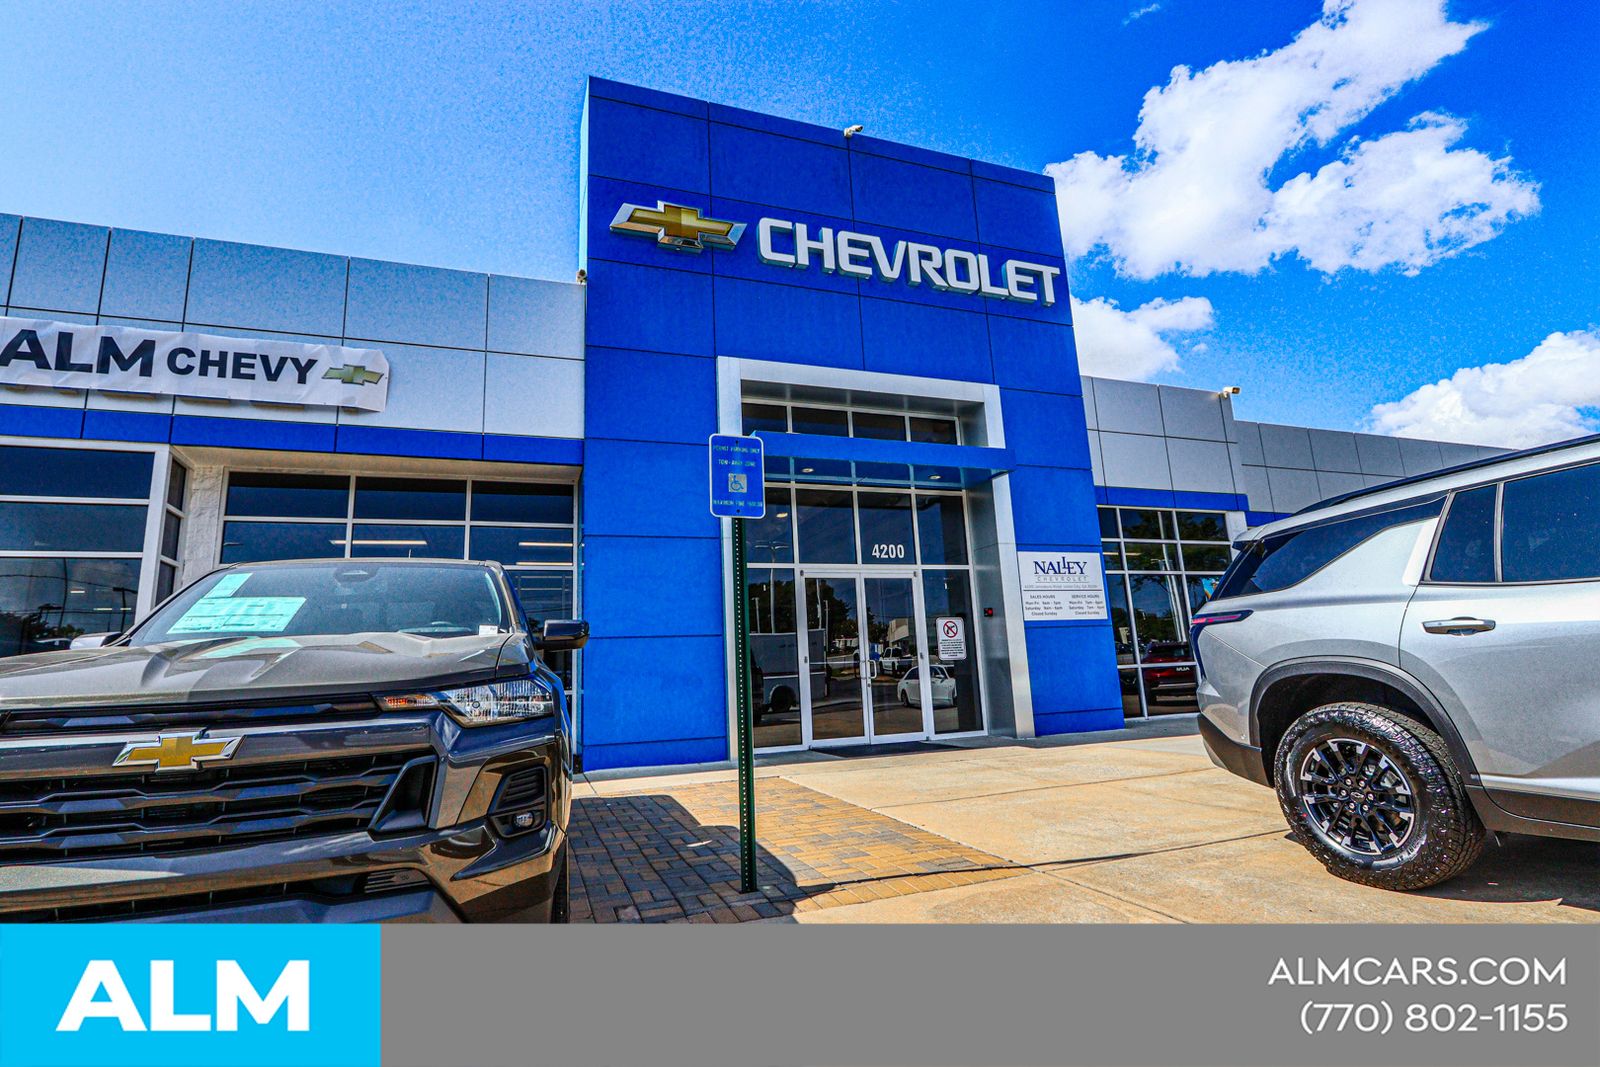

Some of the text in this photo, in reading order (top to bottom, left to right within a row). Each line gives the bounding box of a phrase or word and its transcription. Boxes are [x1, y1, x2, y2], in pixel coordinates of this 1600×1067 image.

[757, 217, 1060, 306] CHEVROLET
[0, 329, 318, 385] ALM CHEVY
[872, 544, 905, 559] 4200
[1033, 556, 1087, 575] NALLEY
